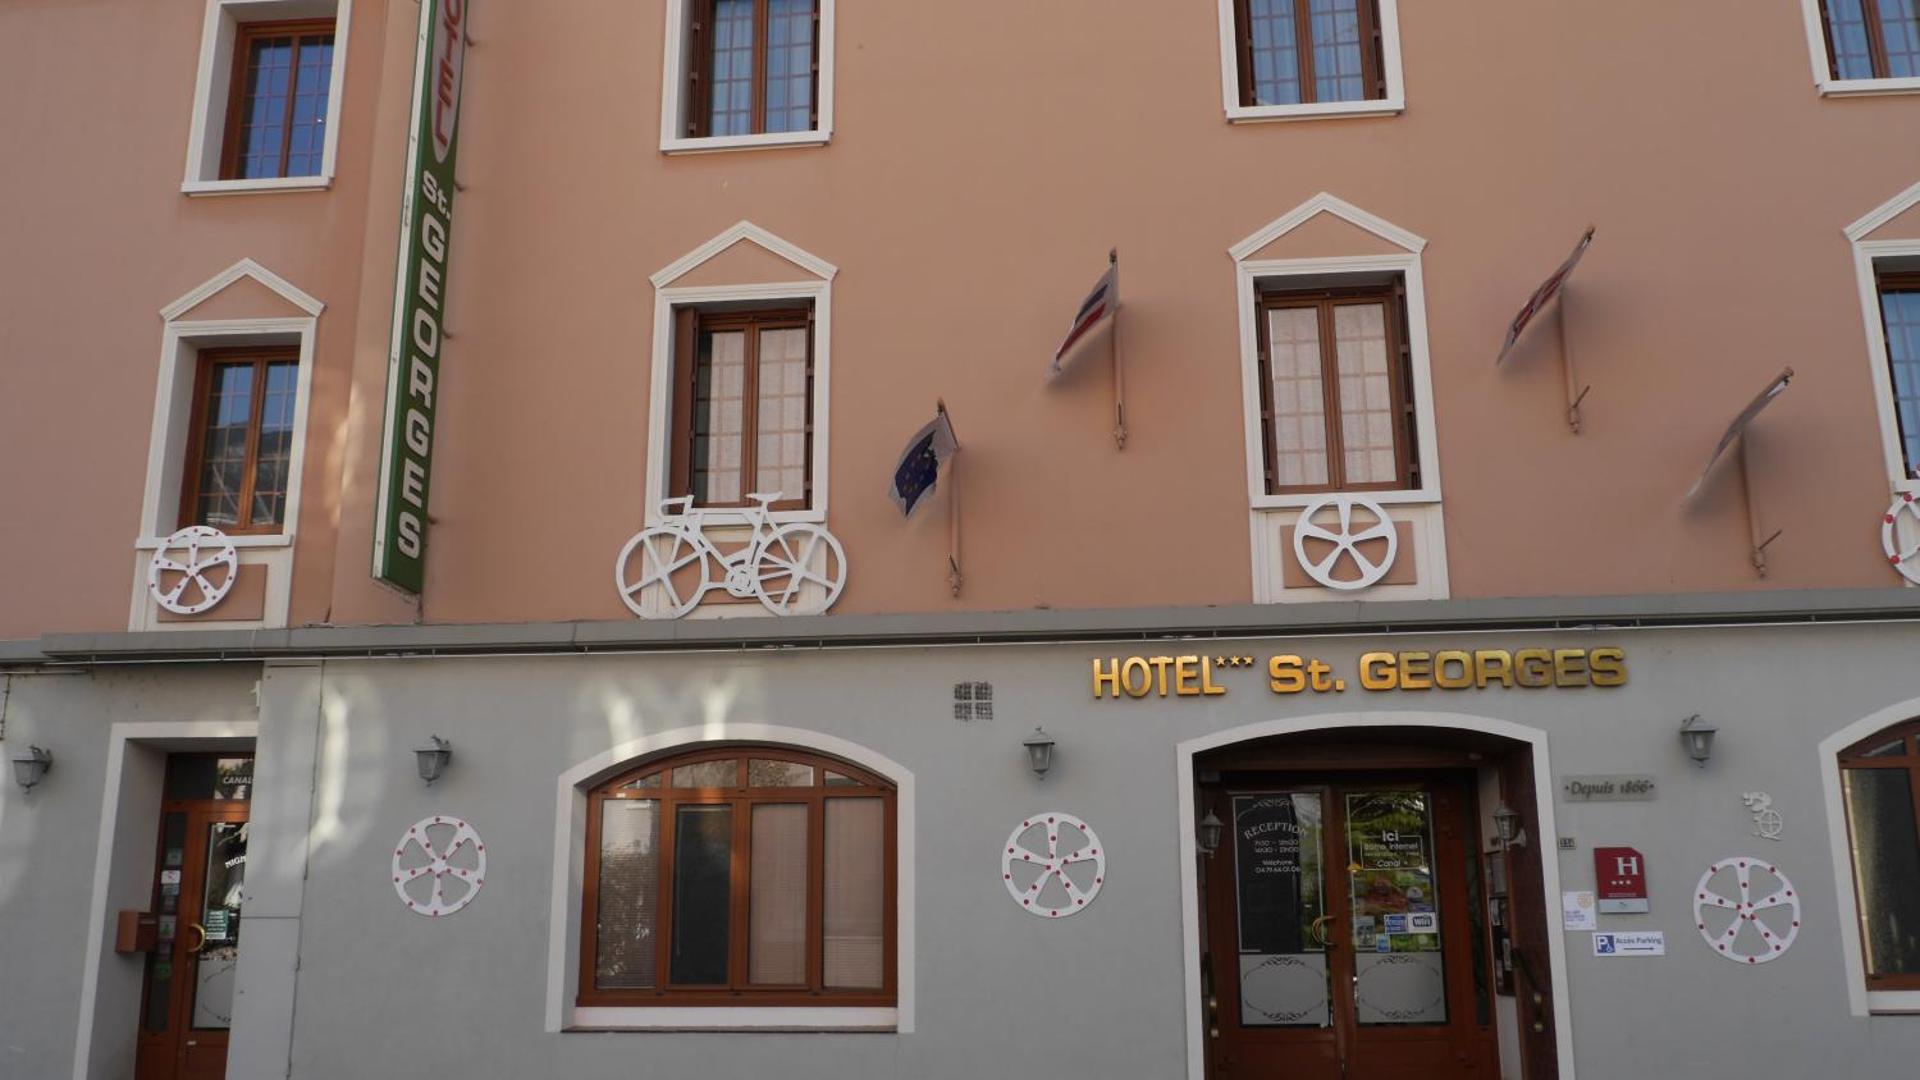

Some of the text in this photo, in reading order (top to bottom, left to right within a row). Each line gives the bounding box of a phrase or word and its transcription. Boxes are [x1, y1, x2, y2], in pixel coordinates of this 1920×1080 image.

[398, 169, 451, 559] St. GEORGES
[1092, 647, 1629, 699] HOTEL St. GEORGES
[1570, 779, 1648, 798] Depuis 1866
[1382, 830, 1399, 842] Ici
[1377, 859, 1400, 867] Canal
[1617, 856, 1638, 876] H
